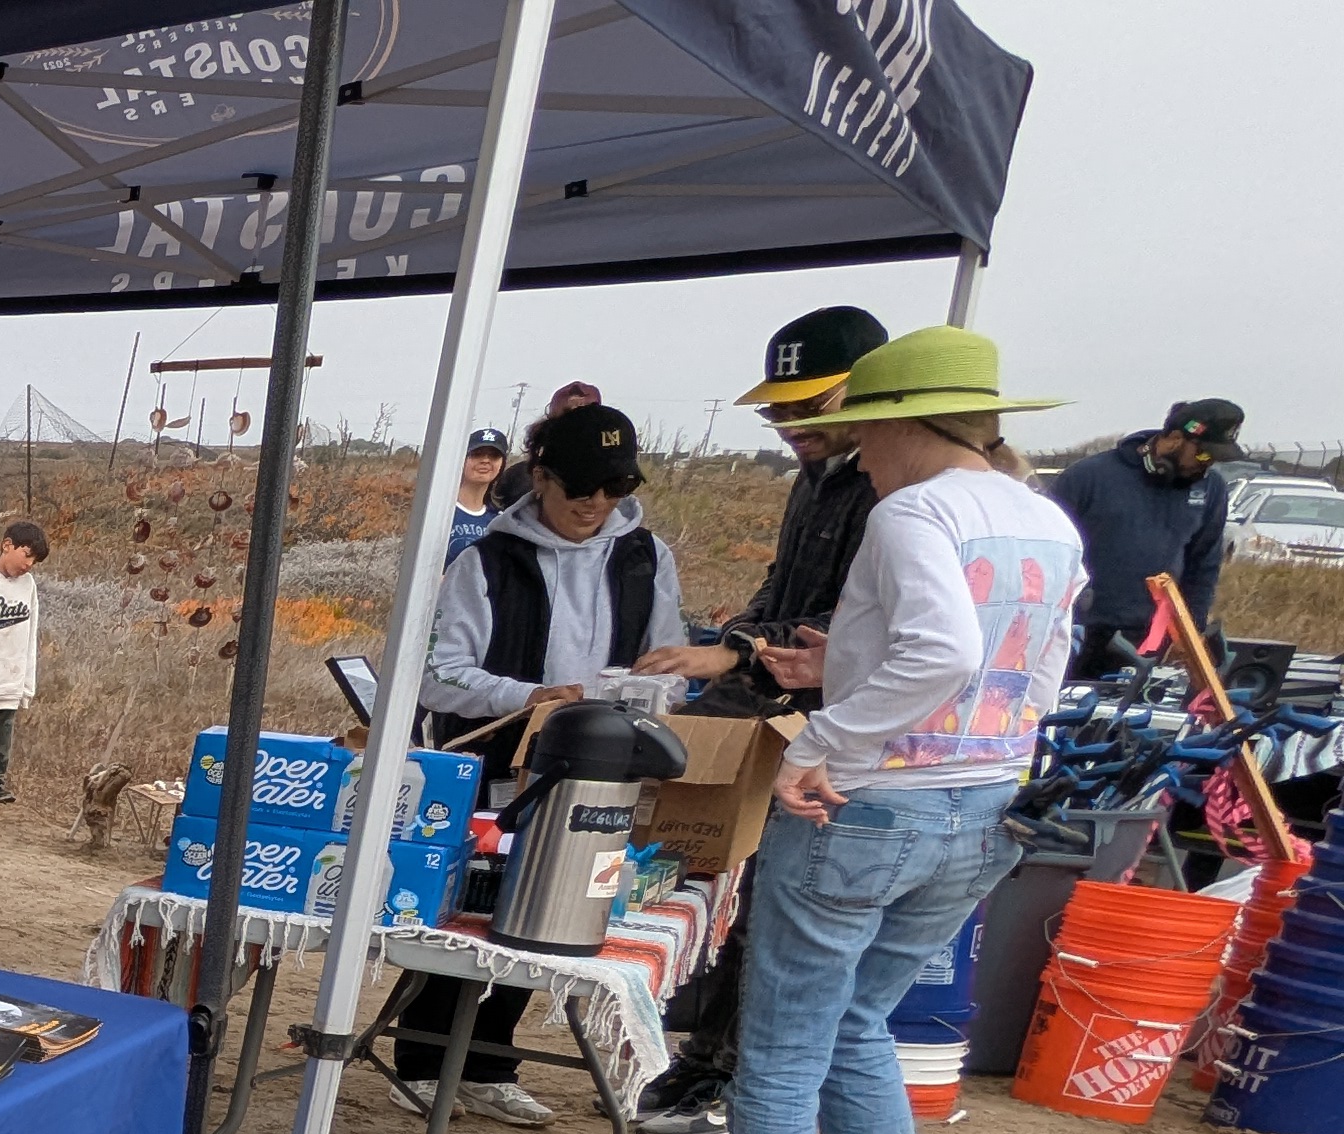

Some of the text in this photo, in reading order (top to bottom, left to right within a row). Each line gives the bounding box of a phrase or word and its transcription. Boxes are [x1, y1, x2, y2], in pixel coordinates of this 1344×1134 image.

[804, 51, 917, 177] KEEPERS
[776, 342, 803, 376] H
[482, 429, 495, 442] LA
[456, 763, 474, 777] 12
[252, 777, 327, 810] ater
[425, 852, 441, 867] 12
[1093, 1030, 1148, 1060] THE
